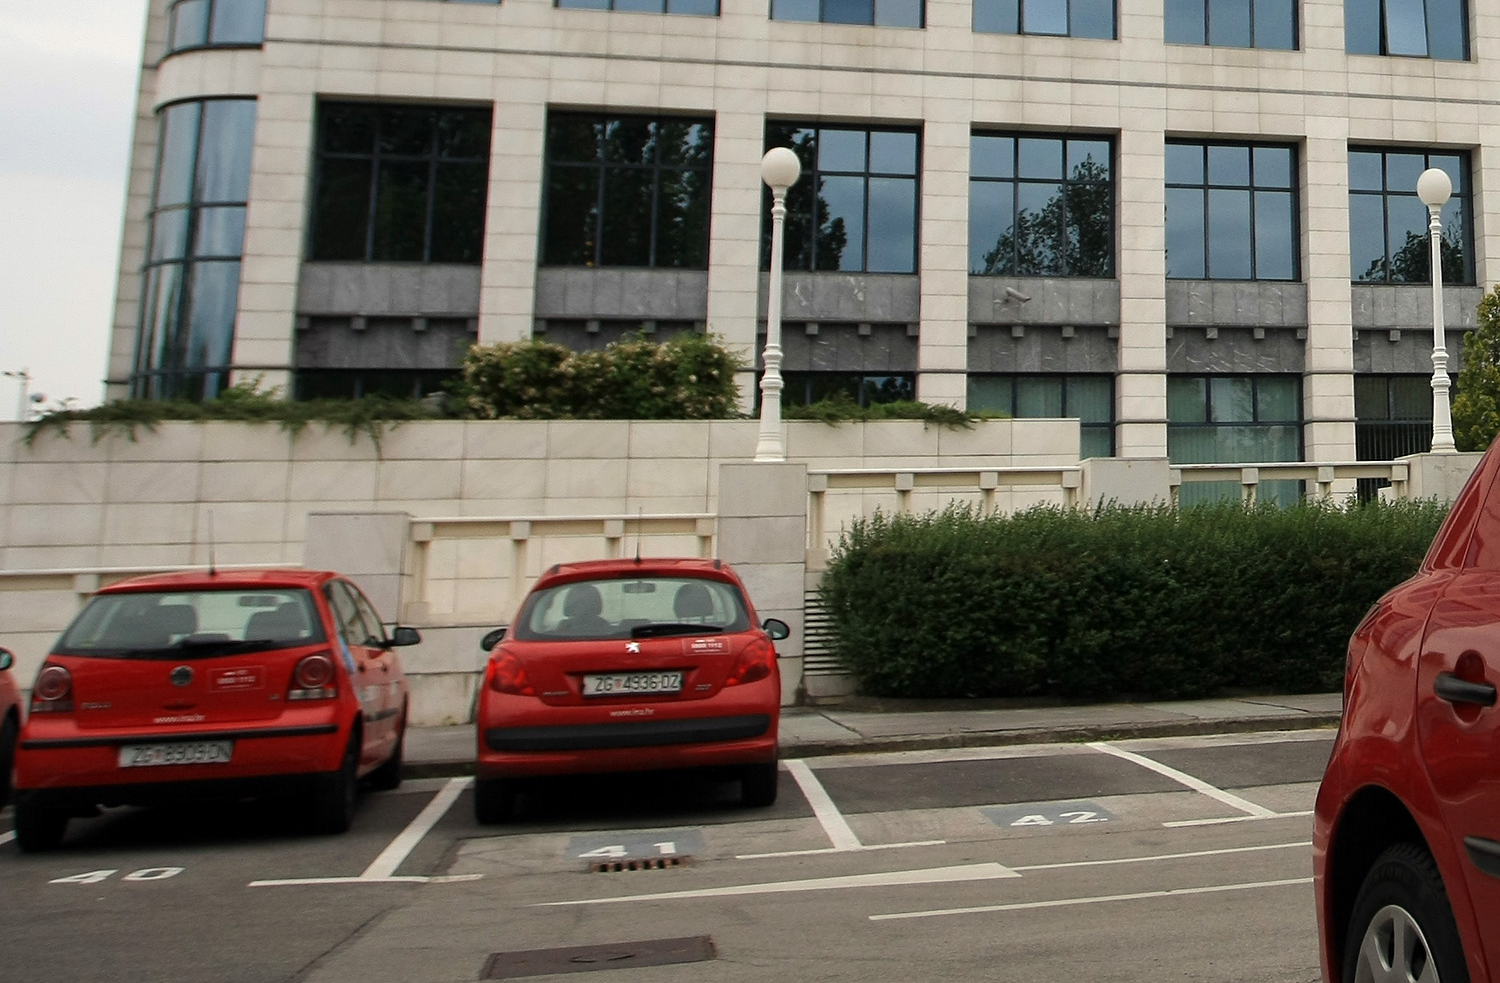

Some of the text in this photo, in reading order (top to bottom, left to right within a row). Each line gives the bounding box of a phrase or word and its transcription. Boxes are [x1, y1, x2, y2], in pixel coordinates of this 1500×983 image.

[1010, 811, 1108, 826] 42
[578, 841, 676, 858] 41
[48, 867, 186, 884] 40
